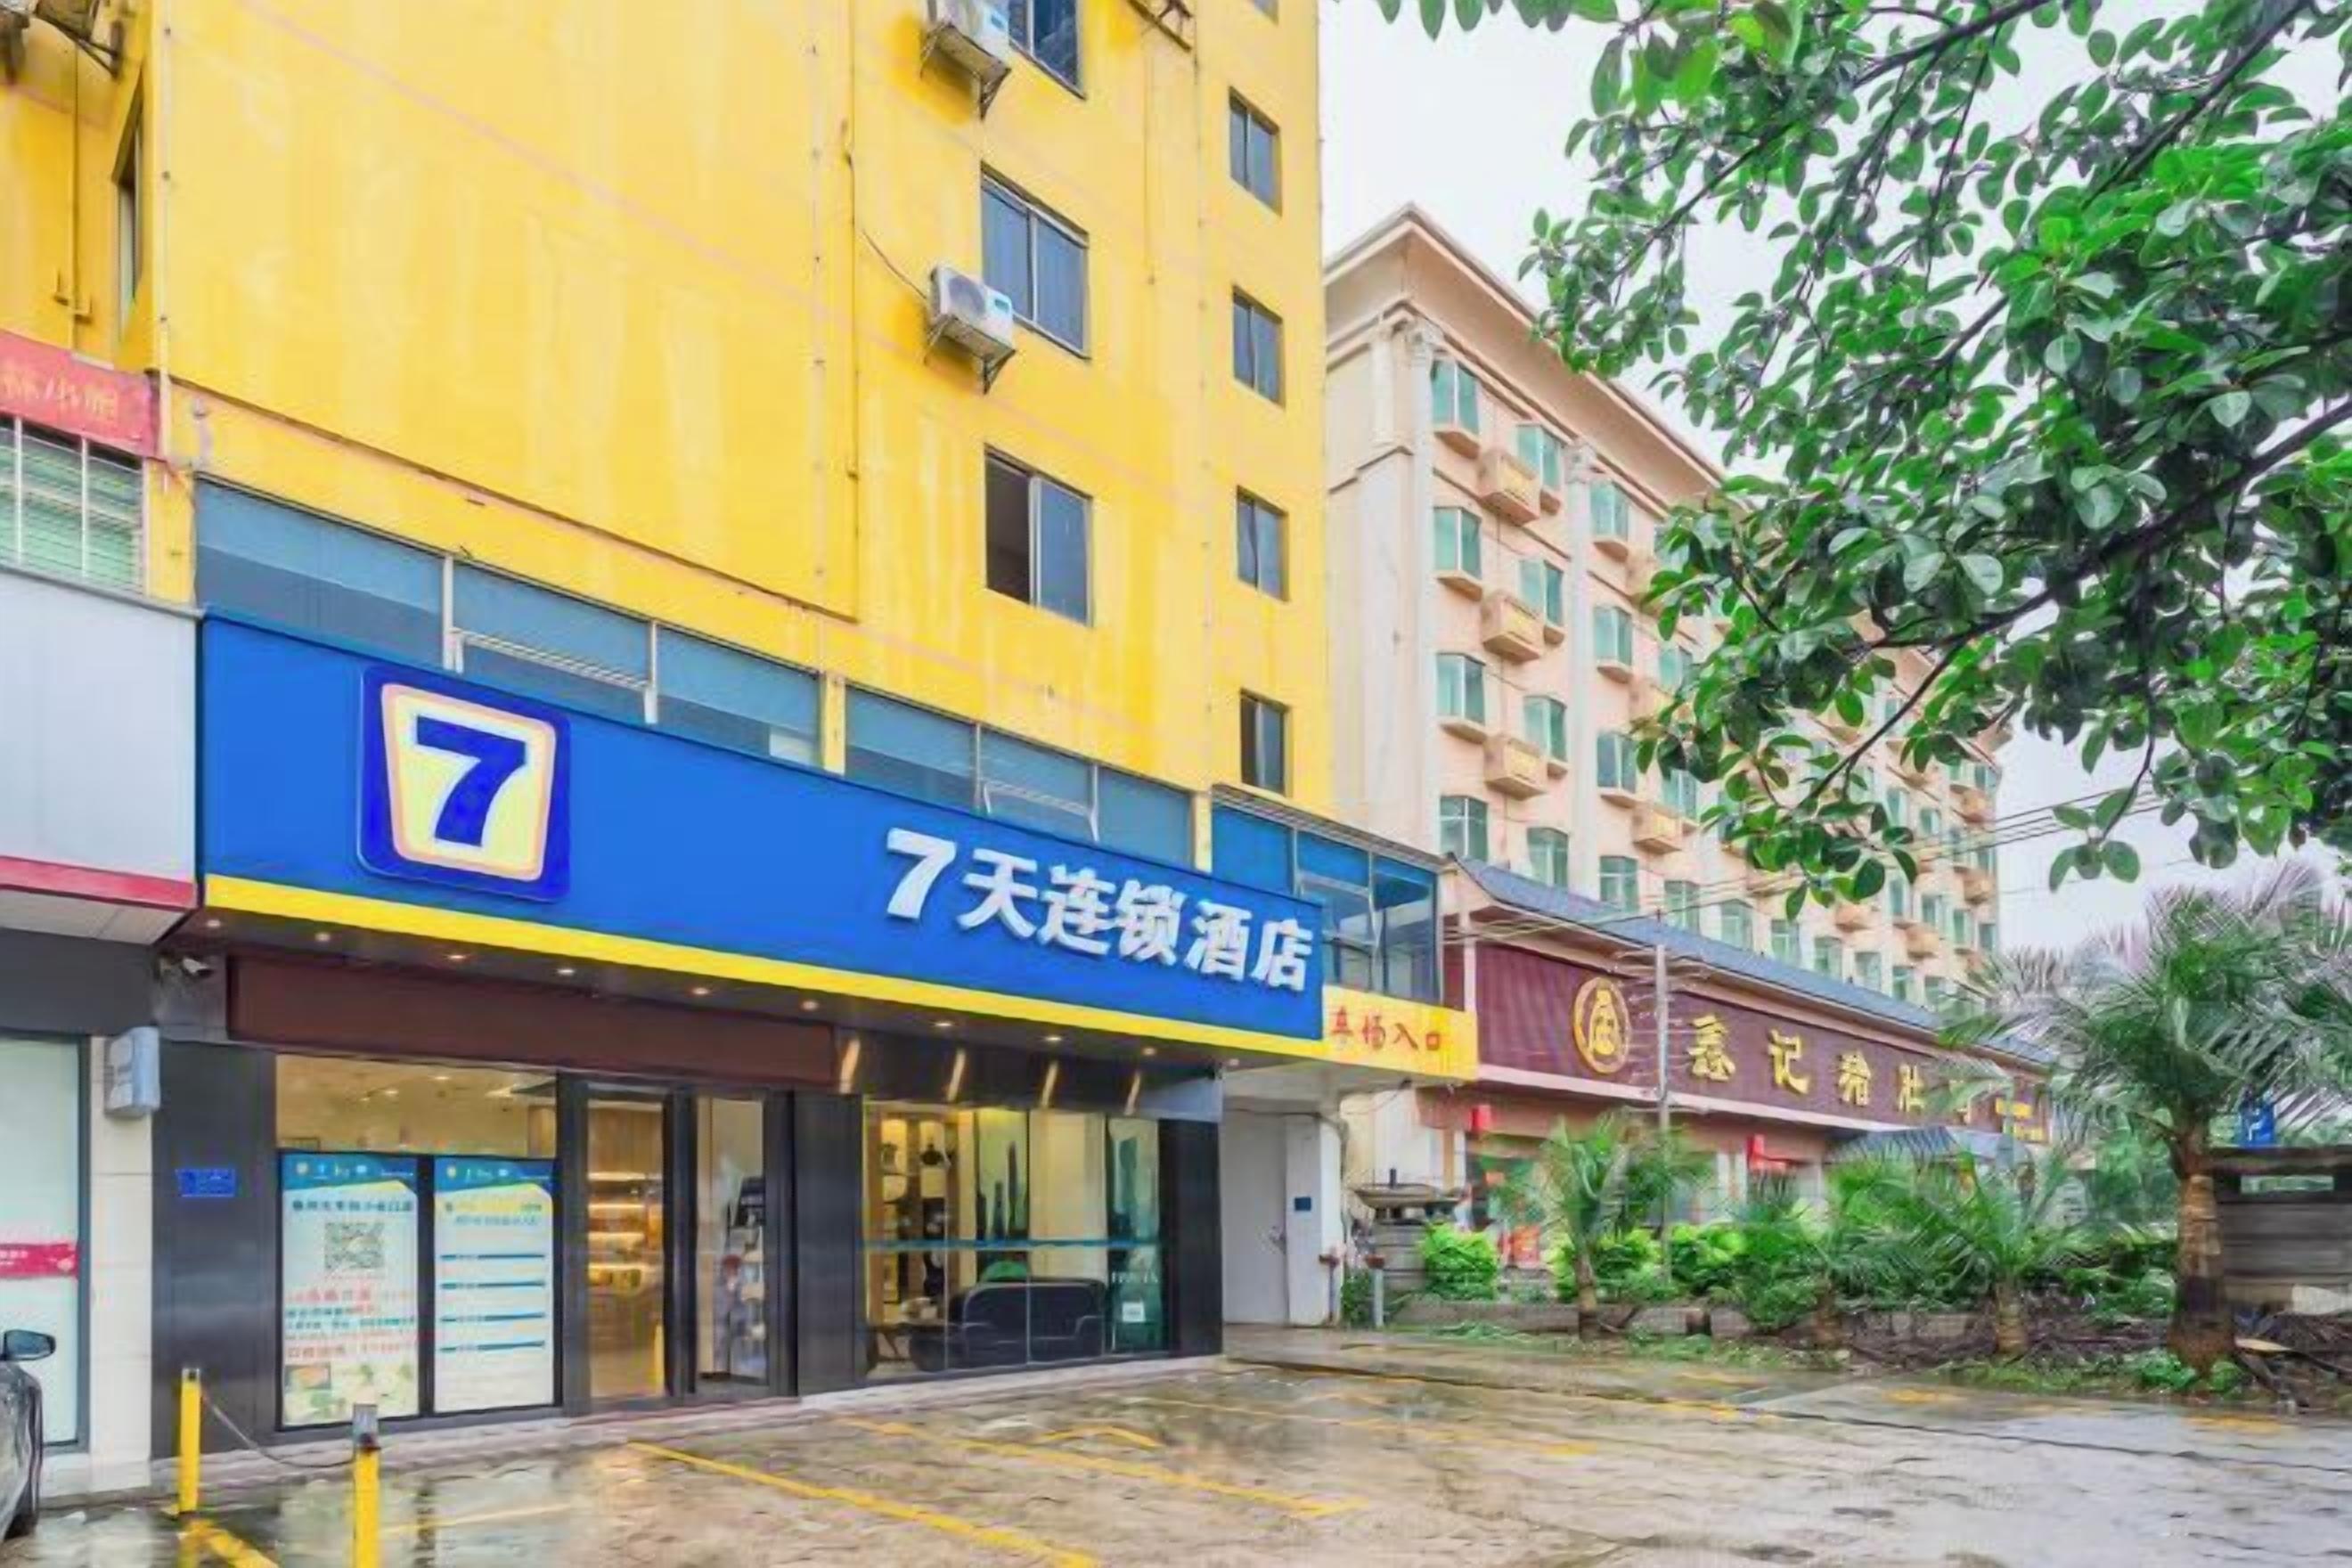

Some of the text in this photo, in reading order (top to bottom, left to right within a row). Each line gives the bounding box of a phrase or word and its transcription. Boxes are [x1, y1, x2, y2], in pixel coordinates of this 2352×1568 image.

[416, 715, 526, 847] 7
[886, 827, 1313, 992] 7天连锁酒店
